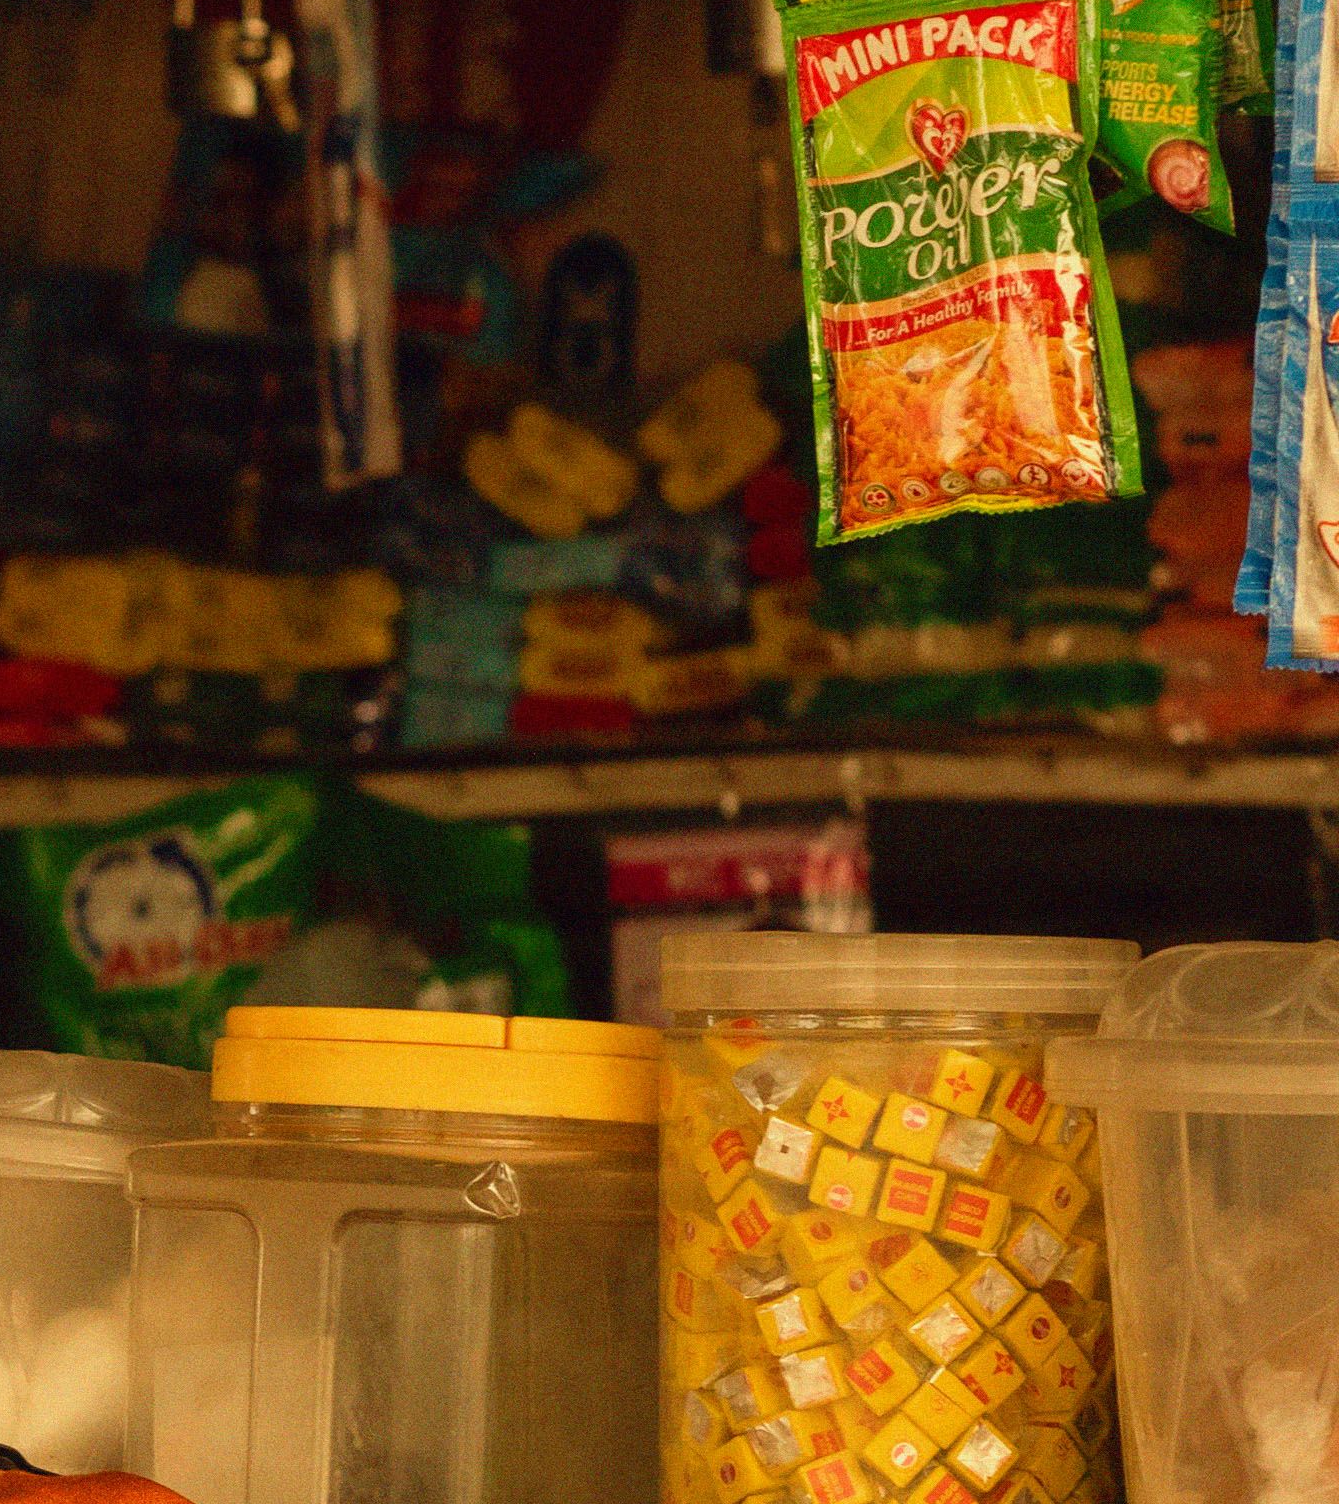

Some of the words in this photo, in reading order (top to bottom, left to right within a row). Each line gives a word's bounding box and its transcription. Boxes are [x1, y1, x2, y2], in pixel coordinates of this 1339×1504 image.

[821, 25, 910, 93] MINI
[923, 14, 1043, 60] PACK
[1108, 102, 1199, 126] RELEASE
[907, 222, 970, 280] Oil
[899, 319, 910, 335] A
[912, 297, 973, 332] Healthy
[976, 281, 1034, 307] Family
